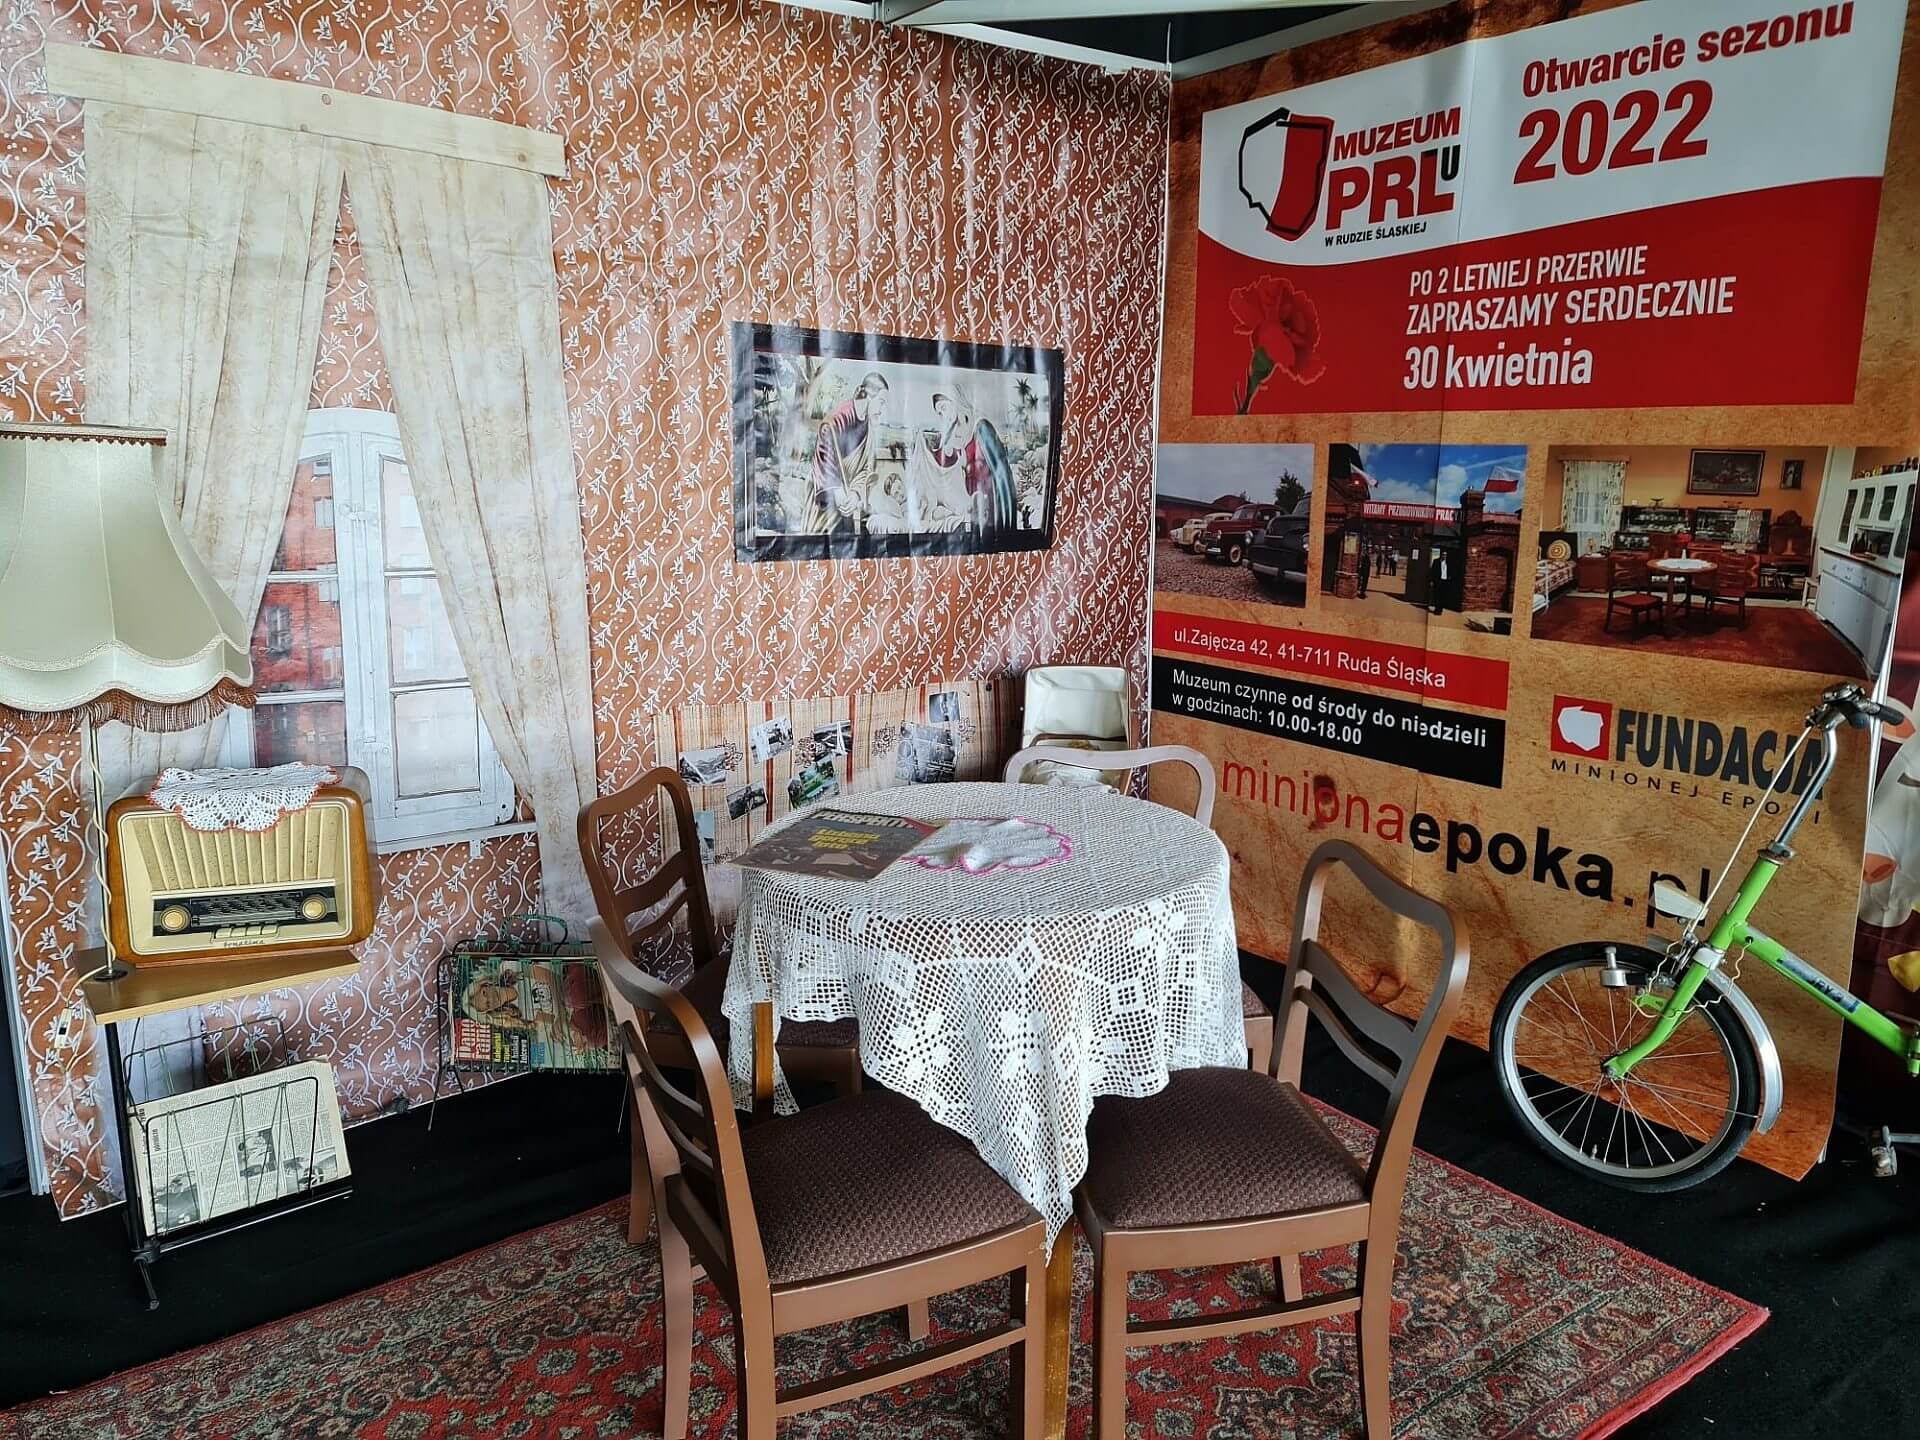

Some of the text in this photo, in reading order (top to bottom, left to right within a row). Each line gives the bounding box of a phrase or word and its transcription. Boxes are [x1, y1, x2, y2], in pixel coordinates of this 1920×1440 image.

[1523, 1, 1854, 98] Otwarcie sezonu
[1333, 106, 1461, 162] MUZEUM
[1513, 79, 1714, 185] 2022
[1325, 235, 1334, 247] W
[1336, 230, 1373, 246] RUDZIE
[1409, 245, 1648, 297] PO 2 LETNIEJ PRZERWIE
[1406, 276, 1737, 335] ZAPRASZAMY SERDECZNIE
[1403, 337, 1593, 390] 30 kwietnia
[1174, 628, 1446, 688] ul.Zajęcza 42, 41-711 Ruda Śląska
[1172, 693, 1362, 745] w godzinach: 10.00-18.00
[1173, 668, 1487, 748] Muzeum czynne od środy do niedzieli
[1615, 708, 1824, 801] FUNDACJA
[1551, 758, 1820, 825] MINIONEJ EPOI
